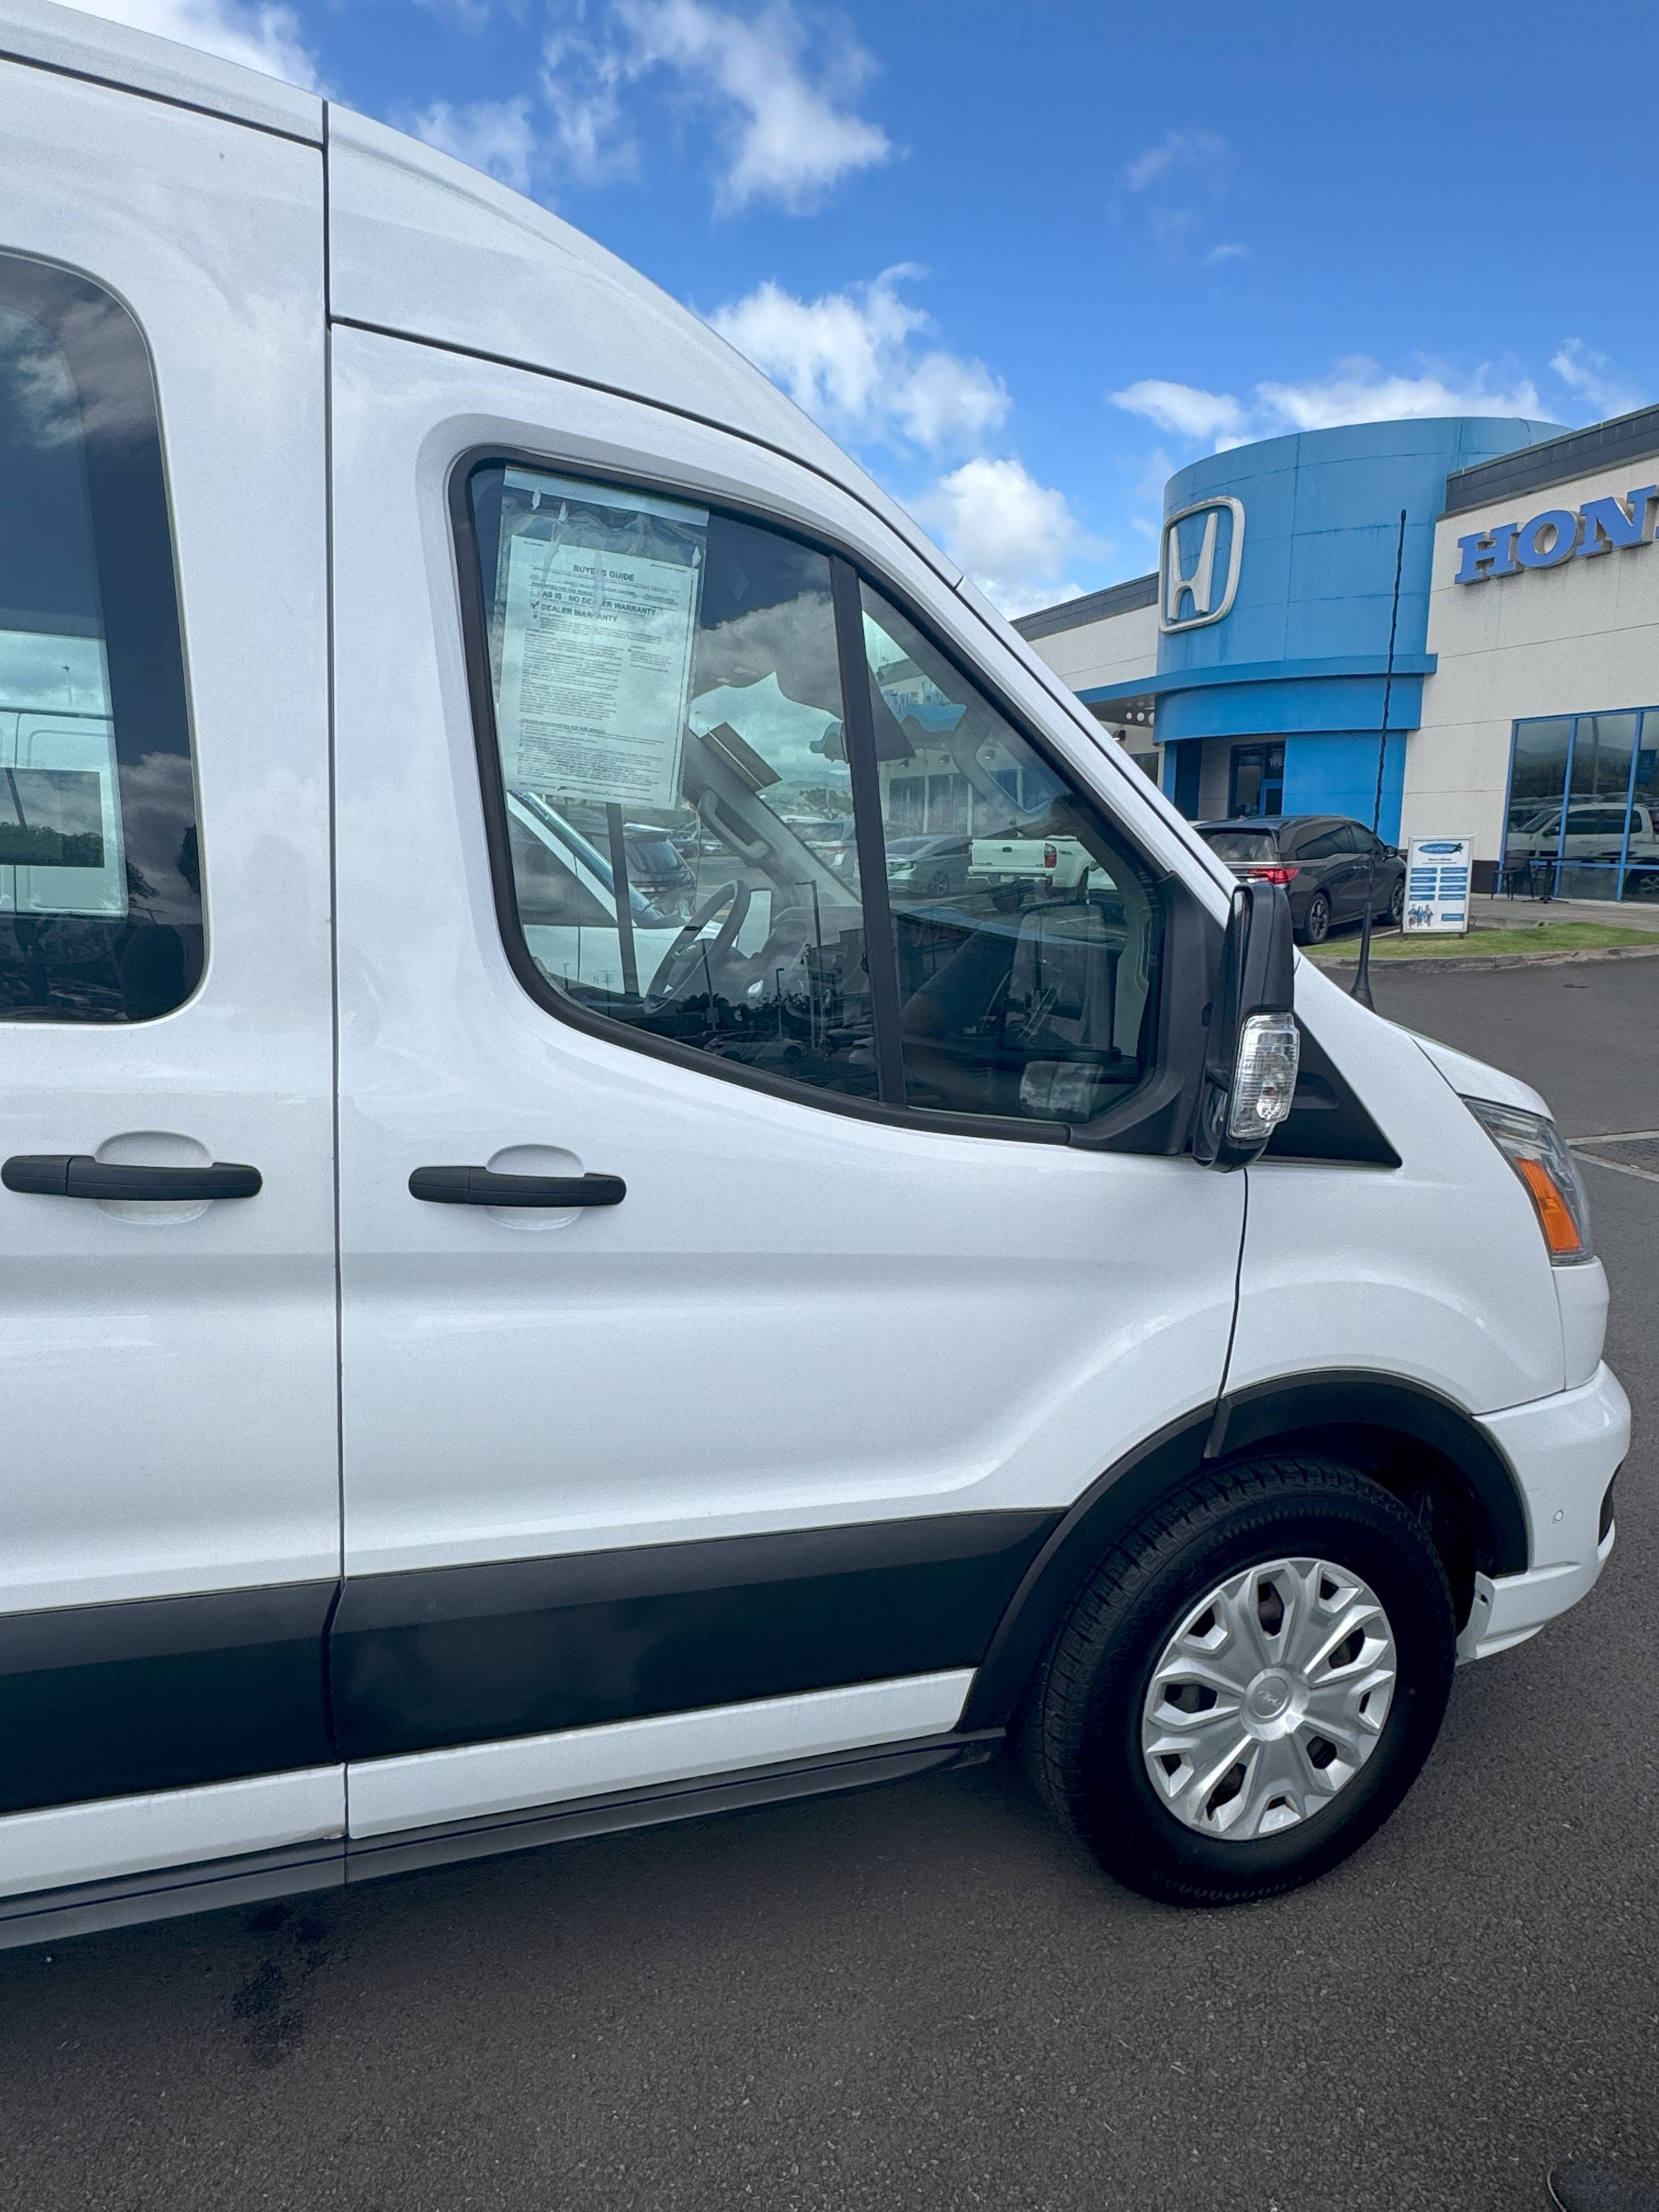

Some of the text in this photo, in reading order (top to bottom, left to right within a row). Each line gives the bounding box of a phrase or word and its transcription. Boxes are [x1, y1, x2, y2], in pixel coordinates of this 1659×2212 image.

[1454, 484, 1659, 585] HON
[573, 564, 607, 577] BUYES
[609, 571, 634, 582] GUIDE
[541, 603, 618, 622] DEALER WARANTY
[614, 602, 656, 616] WARRANTY
